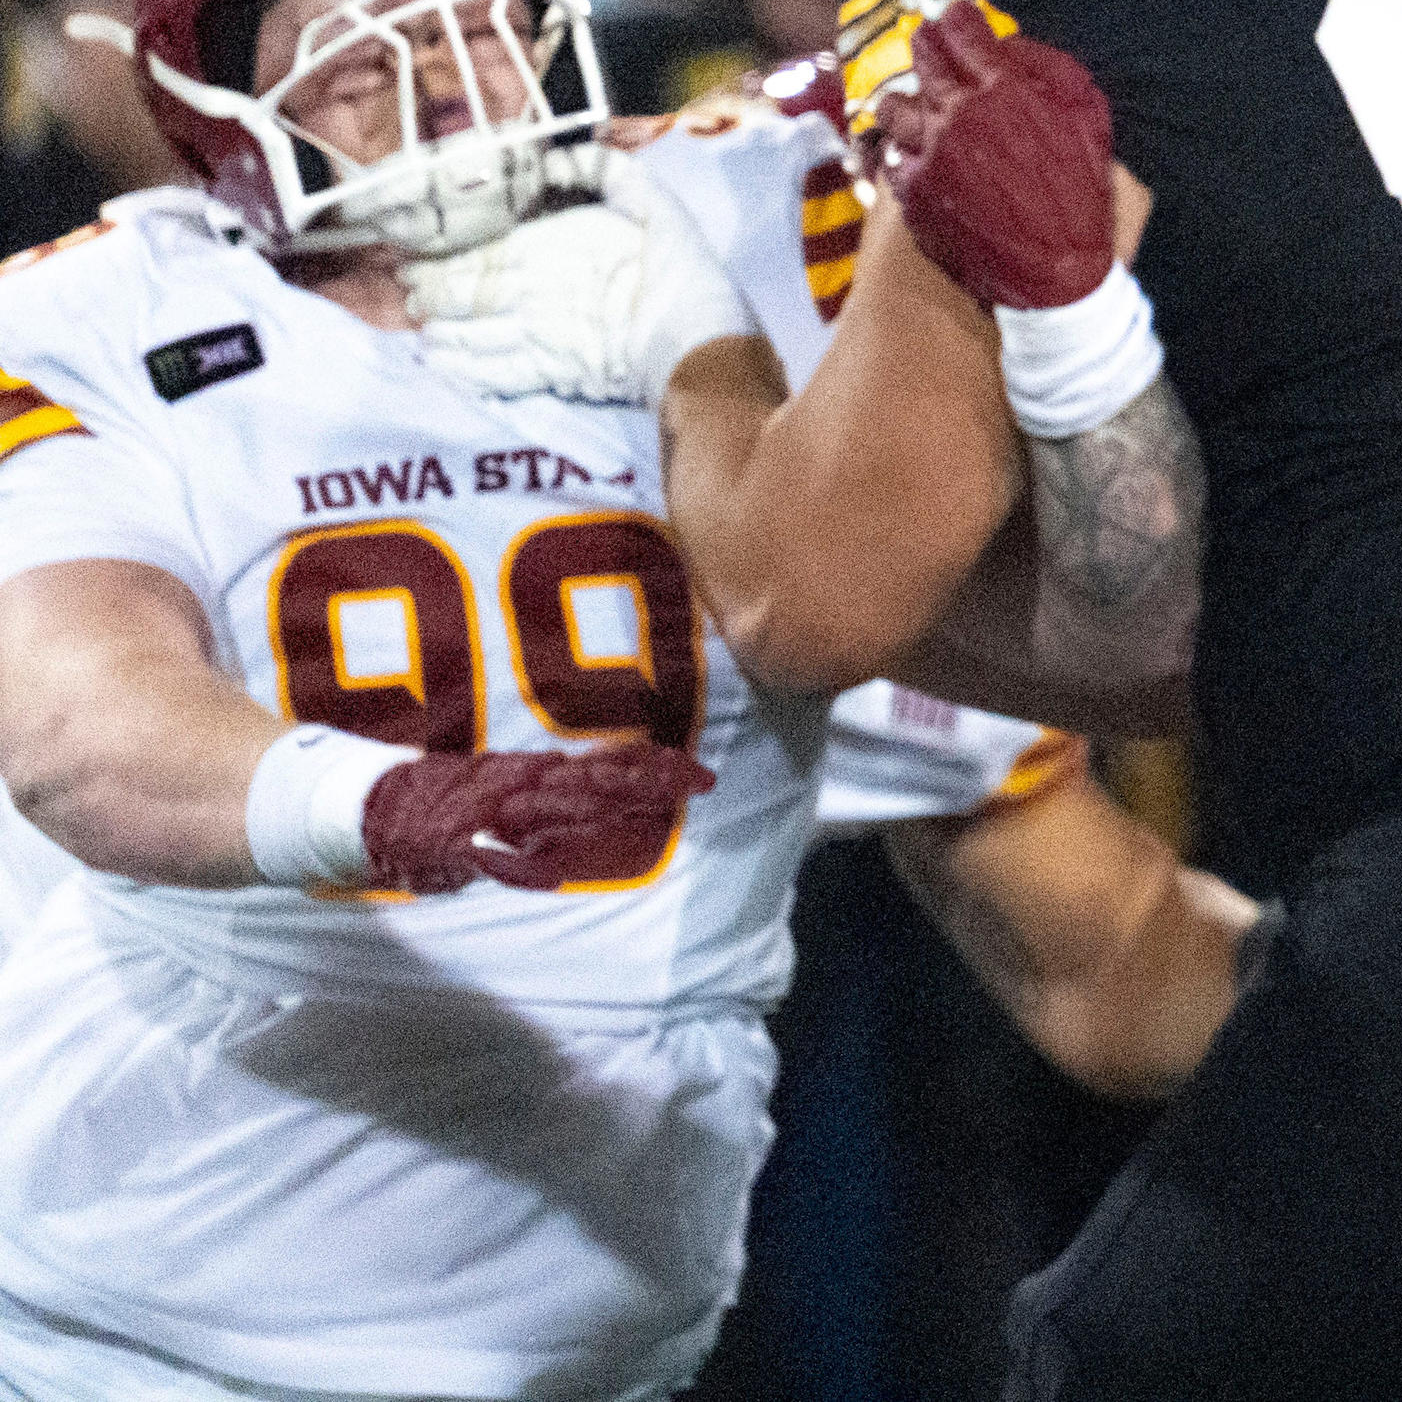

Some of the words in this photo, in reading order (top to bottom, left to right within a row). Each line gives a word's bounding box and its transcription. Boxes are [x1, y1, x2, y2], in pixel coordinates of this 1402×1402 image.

[296, 453, 455, 513] IOWA
[474, 447, 636, 494] STA
[267, 507, 709, 904] 99
